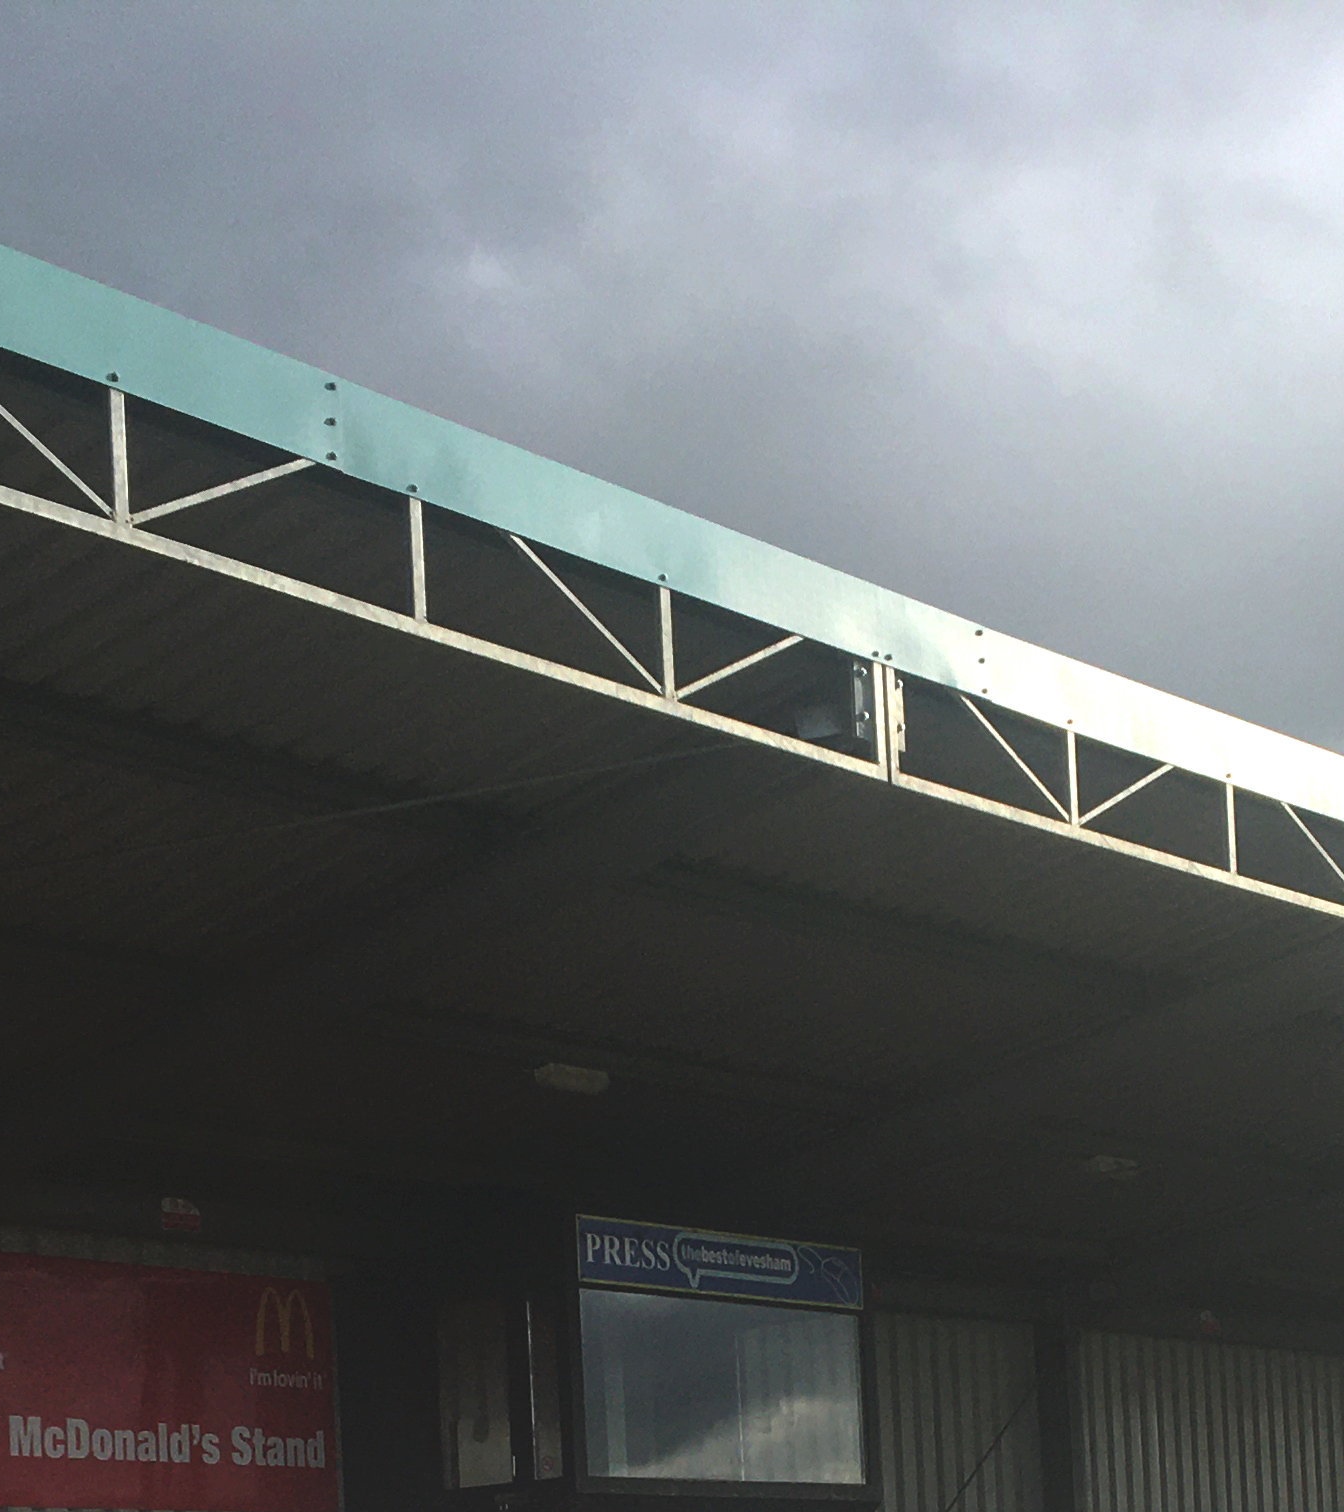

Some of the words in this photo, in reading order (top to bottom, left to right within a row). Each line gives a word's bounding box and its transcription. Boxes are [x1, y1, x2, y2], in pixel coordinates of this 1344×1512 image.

[585, 1232, 671, 1271] PRESS
[8, 1414, 221, 1465] McDonald's
[231, 1424, 325, 1469] Stand
